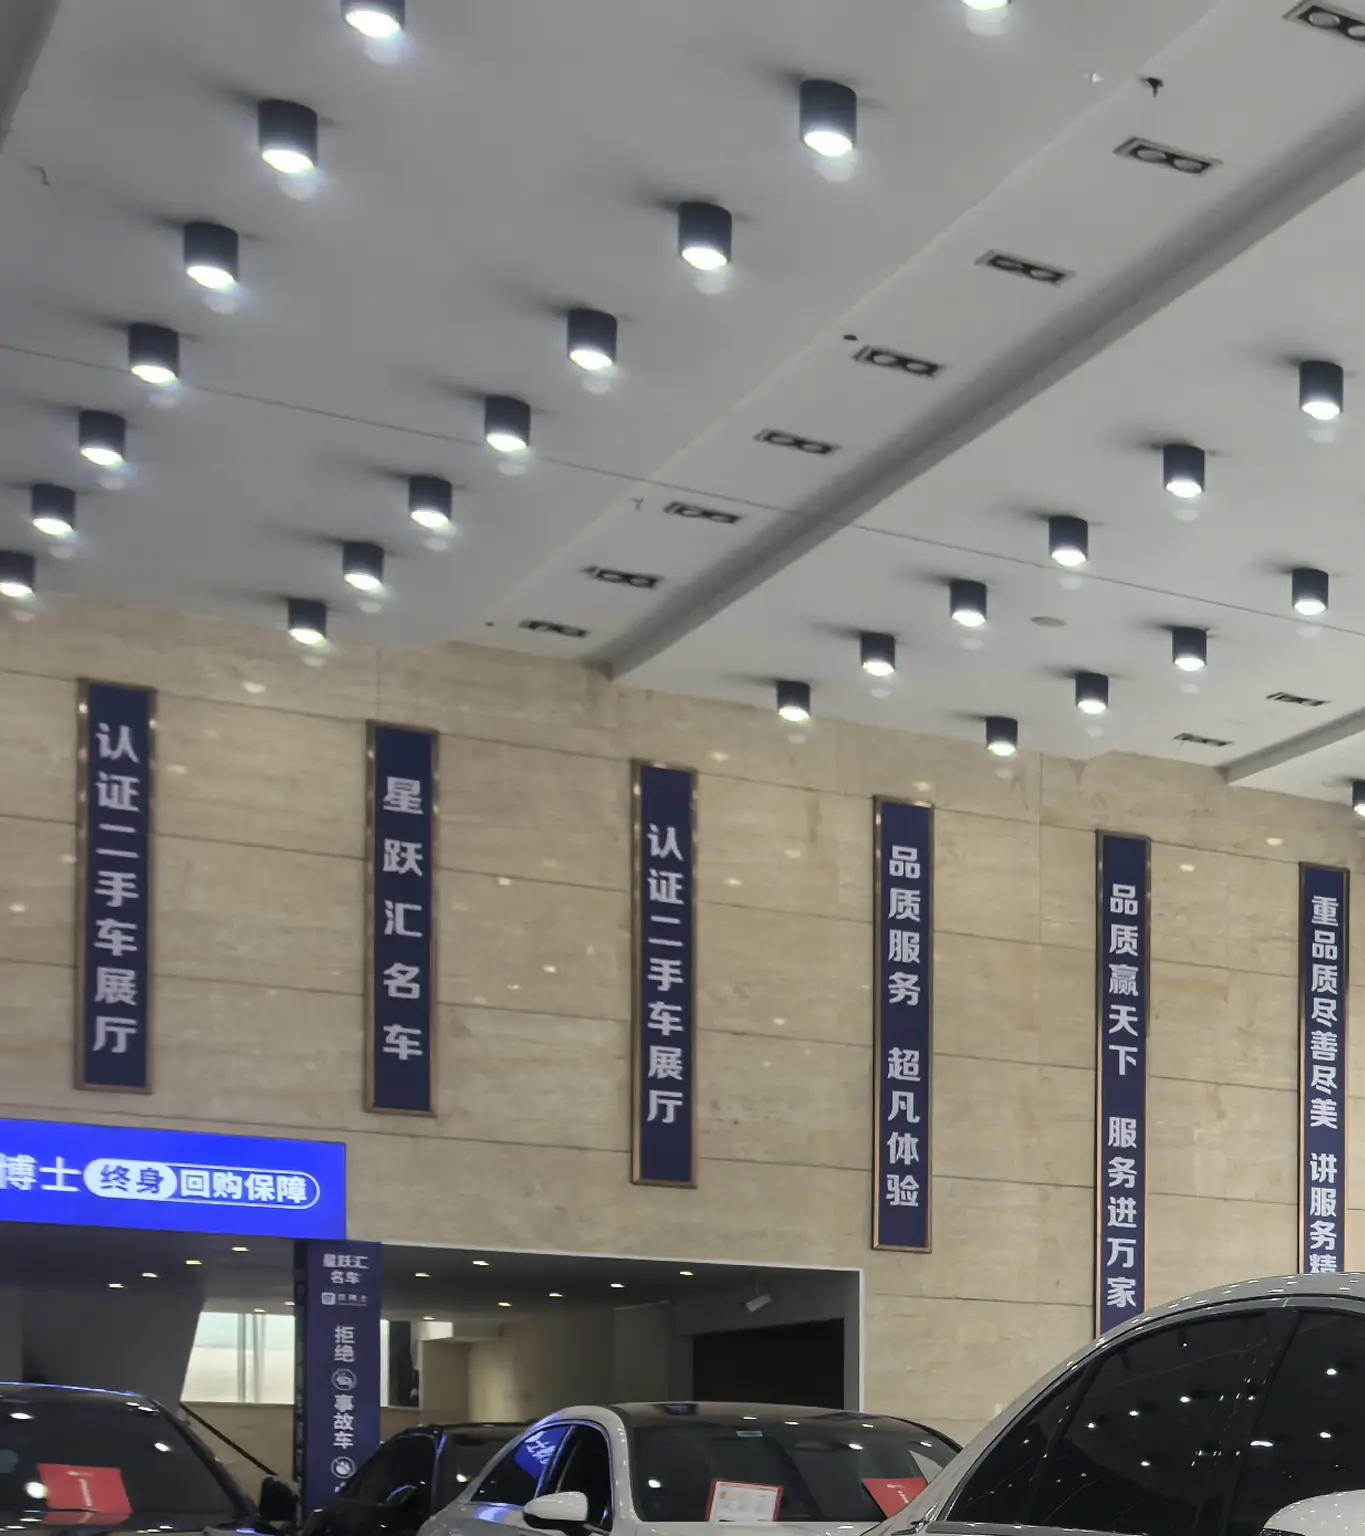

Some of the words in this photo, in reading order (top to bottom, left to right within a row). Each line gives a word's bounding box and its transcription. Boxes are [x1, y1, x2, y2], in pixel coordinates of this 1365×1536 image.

[94, 723, 140, 1053] 认证二手车展厅
[382, 776, 424, 1060] 星跃汇名车
[647, 824, 684, 1125] 认证二手车展厅
[887, 845, 921, 1006] 品质服务
[1108, 883, 1139, 1077] 品质赢天下
[1310, 896, 1339, 1129] 重品质尽善尽美
[100, 1164, 165, 1195] 终身
[180, 1168, 308, 1204] 回购保障
[886, 1047, 921, 1207] 超凡体验
[1107, 1117, 1138, 1308] 服务进万家
